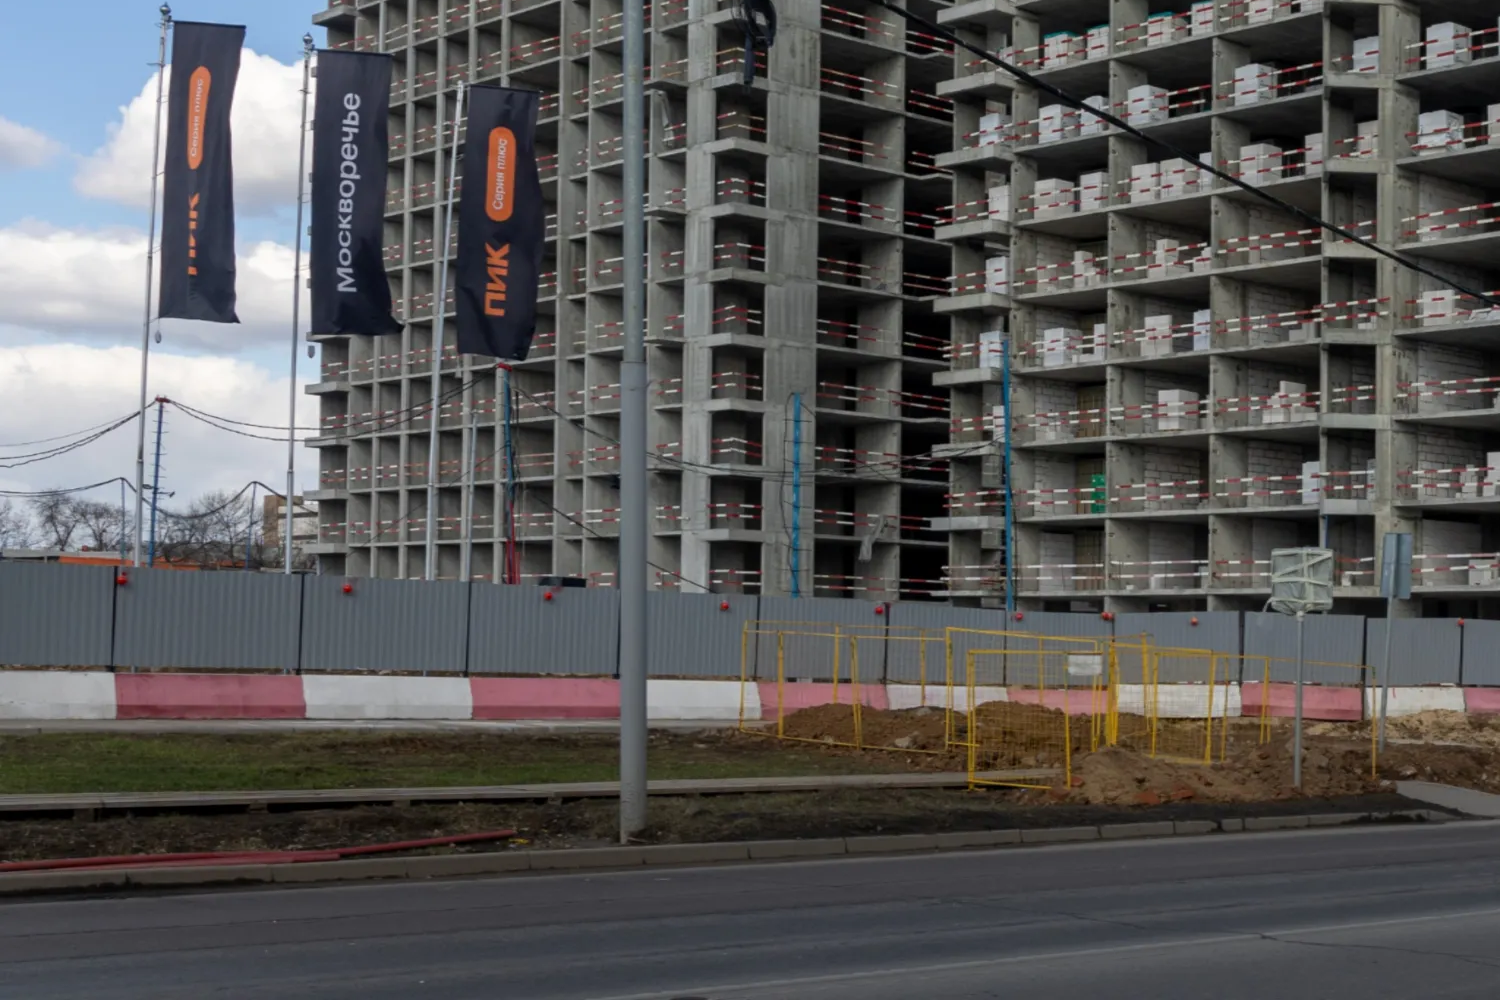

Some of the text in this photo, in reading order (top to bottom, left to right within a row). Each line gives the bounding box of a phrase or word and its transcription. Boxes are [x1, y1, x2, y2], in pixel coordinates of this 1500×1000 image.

[336, 92, 362, 293] Москворечье
[491, 171, 507, 211] Серия
[484, 242, 511, 317] ПИК
